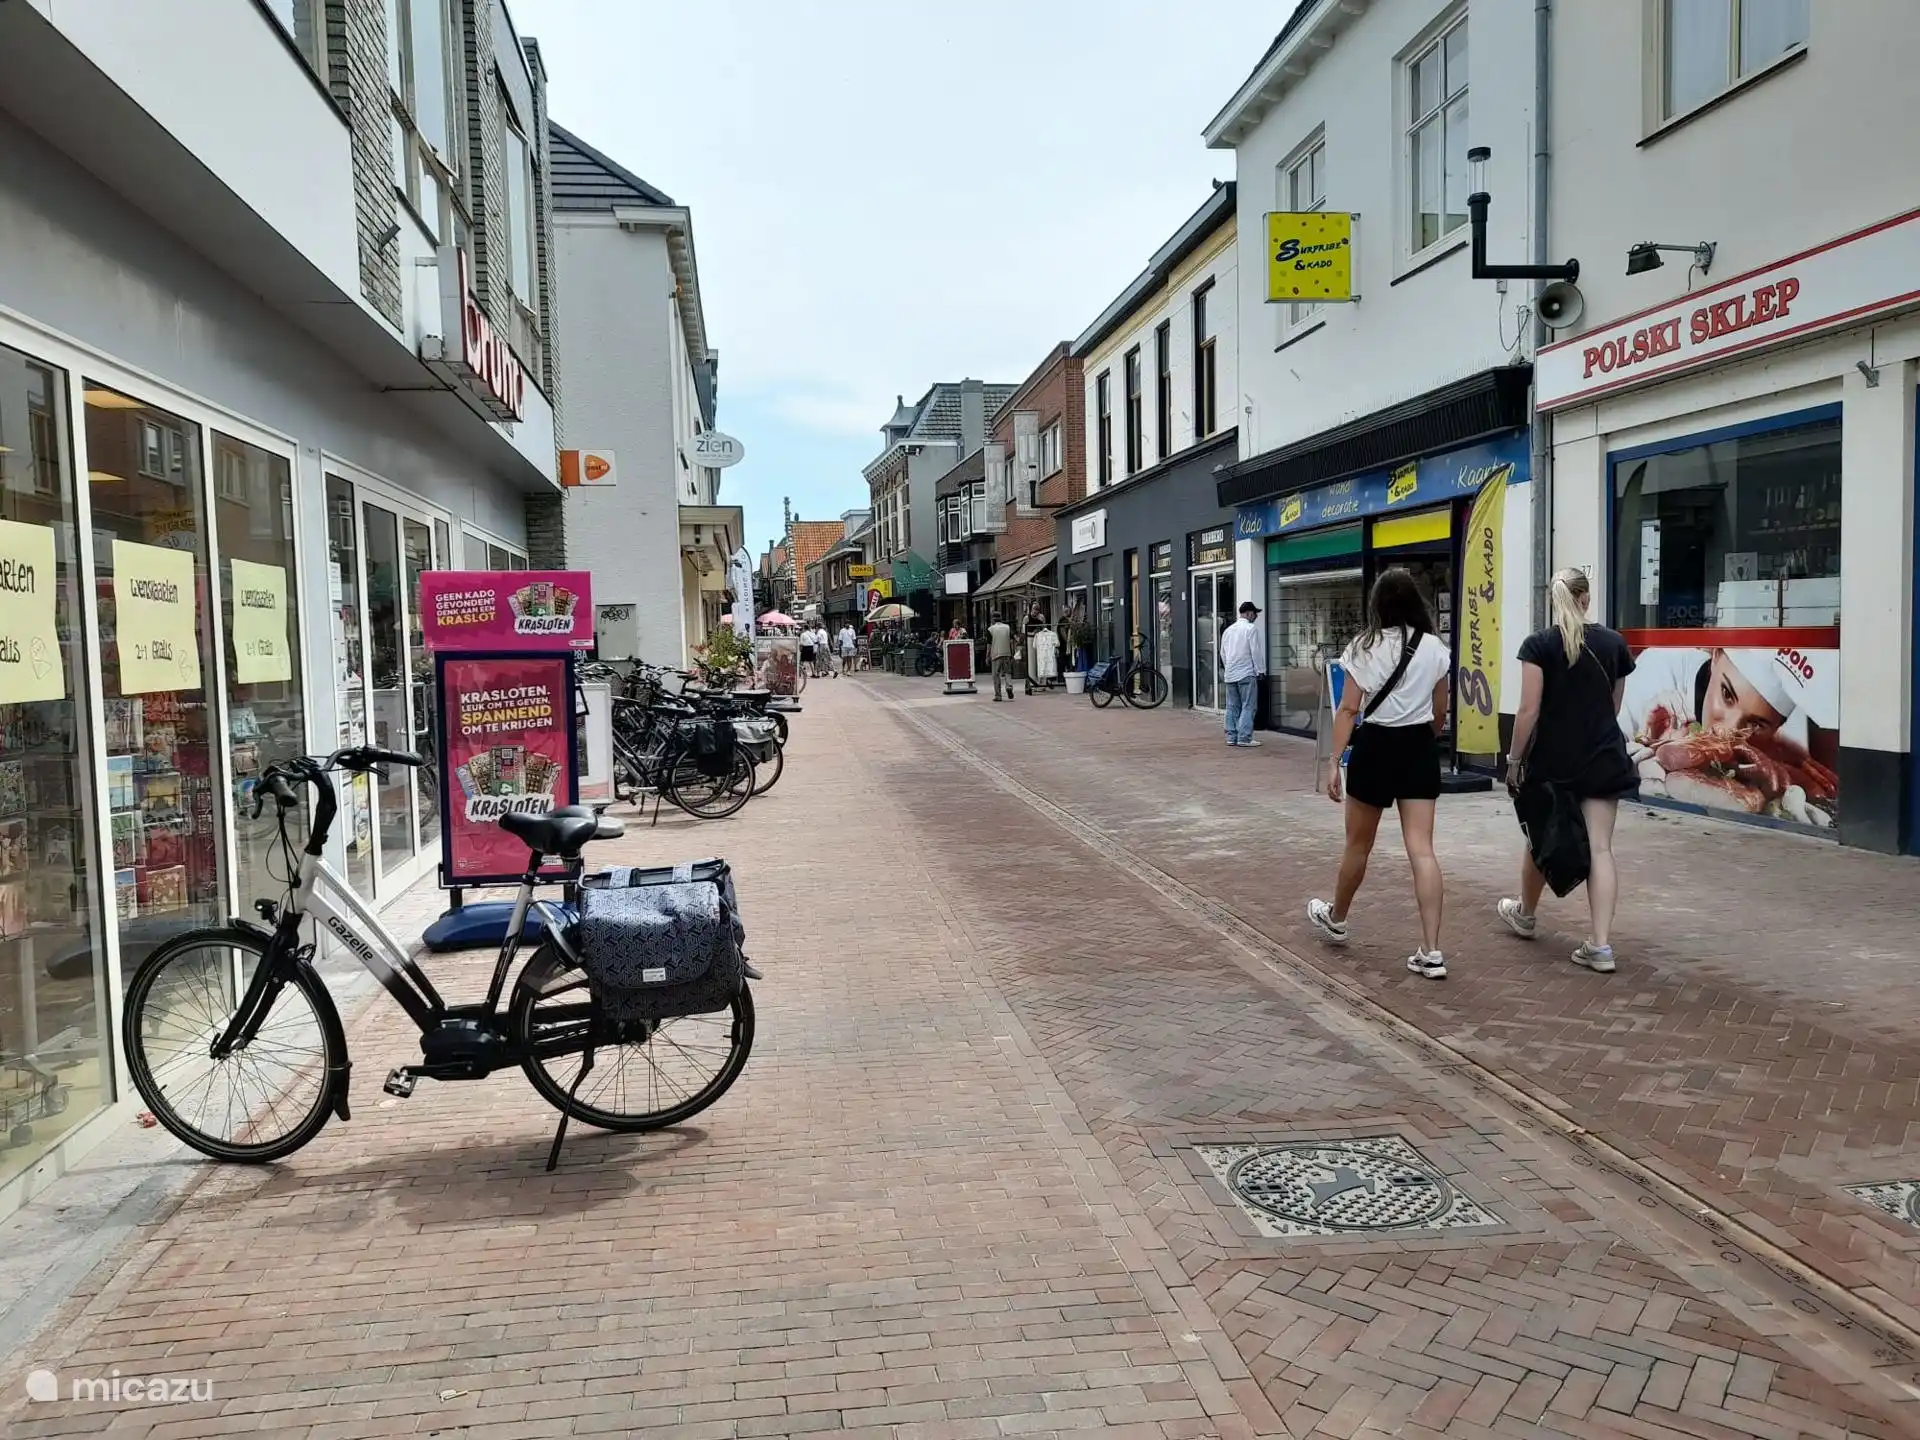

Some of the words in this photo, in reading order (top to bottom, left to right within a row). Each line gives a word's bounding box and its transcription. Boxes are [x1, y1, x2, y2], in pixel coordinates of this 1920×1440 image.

[1294, 260, 1305, 270] &
[1583, 317, 1682, 379] POLSKI
[1690, 277, 1800, 345] SKLEP
[696, 440, 733, 452] zien
[1240, 512, 1263, 535] Kado
[1481, 527, 1494, 579] KADO
[435, 592, 463, 602] GEEN
[465, 589, 496, 599] KADO
[1480, 580, 1495, 604] &
[436, 598, 496, 610] GEVONDEN?
[436, 608, 460, 617] DENK
[461, 606, 478, 614] AAN
[479, 605, 496, 613] EEN
[437, 611, 496, 626] KRASLOT
[518, 617, 571, 631] KRASLOTEN
[1459, 586, 1493, 717] SURPRISE
[460, 685, 551, 704] KRASLOTEN.
[462, 701, 485, 712] LEUK
[487, 700, 502, 710] OM
[517, 697, 551, 706] GEVEN,
[461, 704, 552, 725] SPANNEND
[461, 724, 484, 735] OM
[486, 723, 500, 733] TE
[502, 717, 553, 732] KRIJGEN
[328, 916, 373, 961] Gazelle
